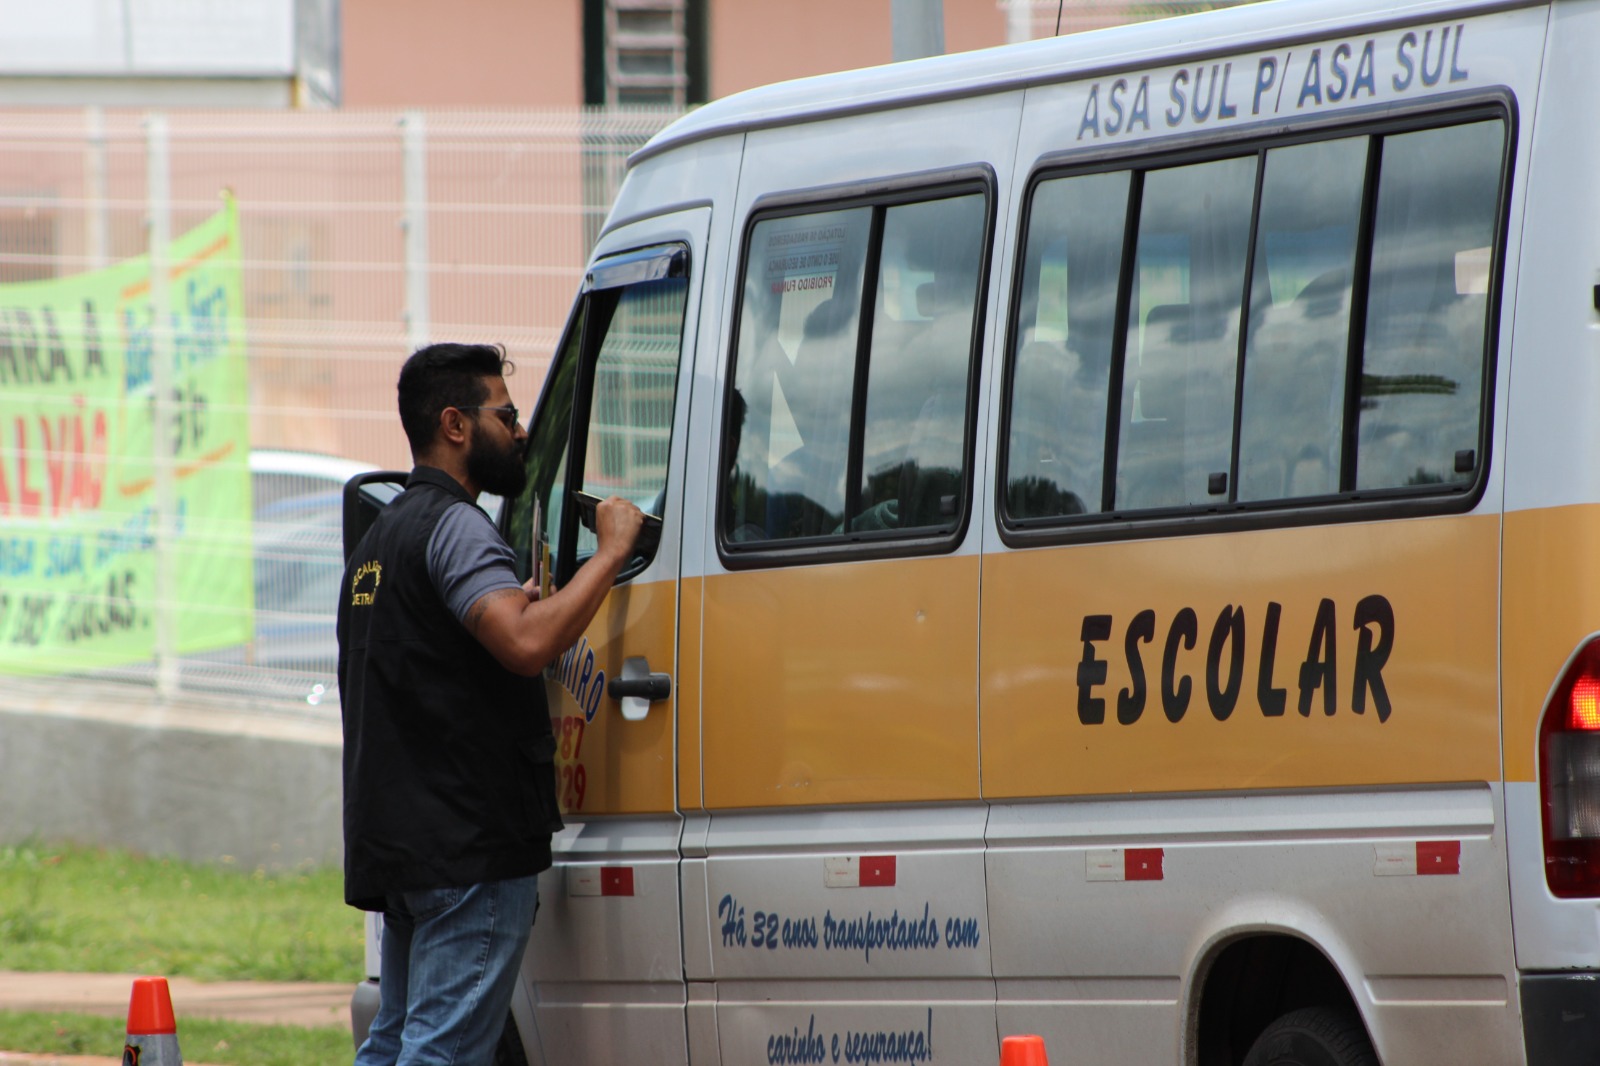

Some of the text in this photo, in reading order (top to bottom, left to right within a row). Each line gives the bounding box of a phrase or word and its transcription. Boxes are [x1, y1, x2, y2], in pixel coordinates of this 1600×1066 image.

[1077, 24, 1469, 140] ASA SUL P/ ASA SUL
[1076, 594, 1395, 725] ESCOLAR
[751, 910, 779, 950] 32
[782, 915, 819, 949] anos
[823, 901, 940, 964] transportando
[945, 916, 980, 949] com
[767, 1013, 826, 1066] carinho
[831, 1032, 841, 1064] e
